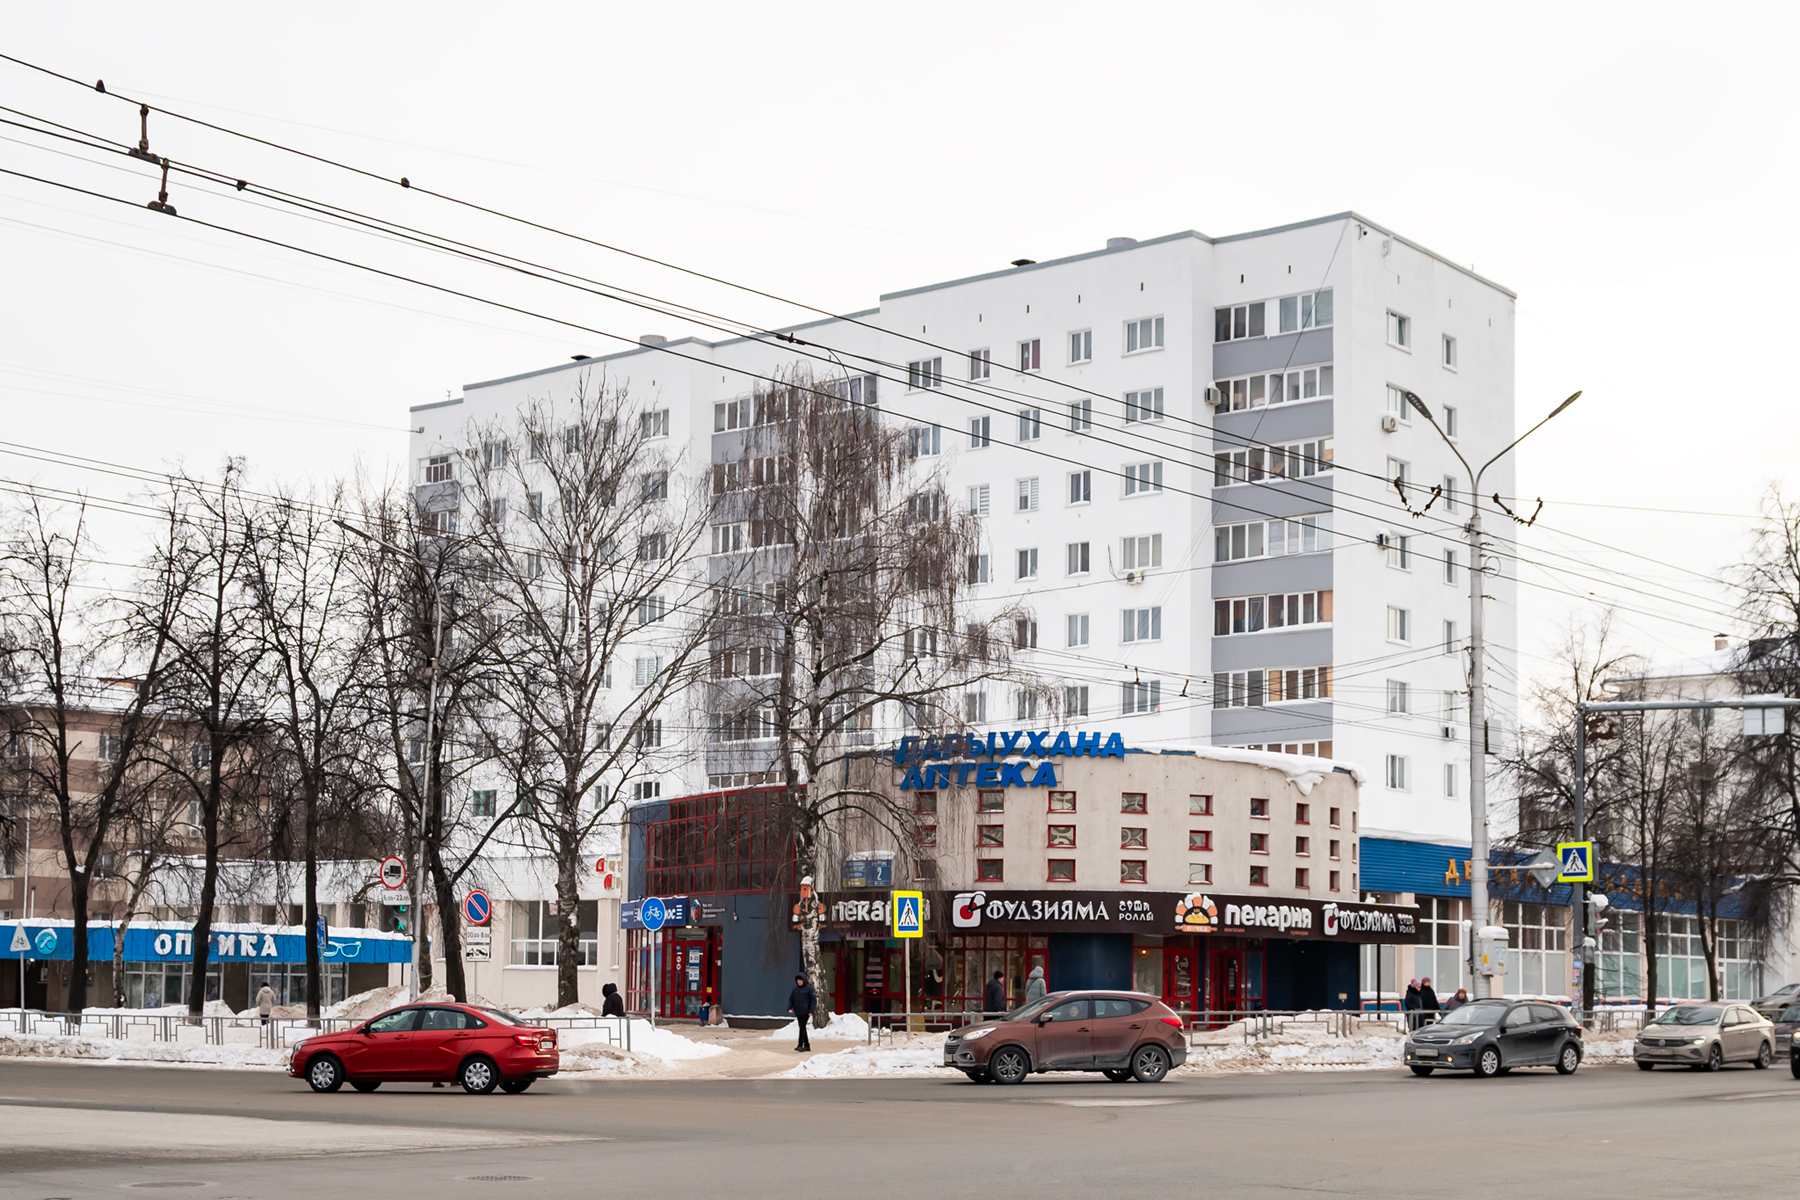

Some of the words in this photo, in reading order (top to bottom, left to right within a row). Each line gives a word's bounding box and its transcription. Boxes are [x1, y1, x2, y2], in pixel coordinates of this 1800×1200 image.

[900, 761, 1057, 790] АПТЕКА
[877, 867, 883, 880] 2
[985, 900, 1110, 921] ФУДЗИЯМА
[1118, 911, 1154, 921] РОЛЛЫ
[1224, 903, 1312, 932] пекарня
[154, 932, 278, 957] ОПИКА
